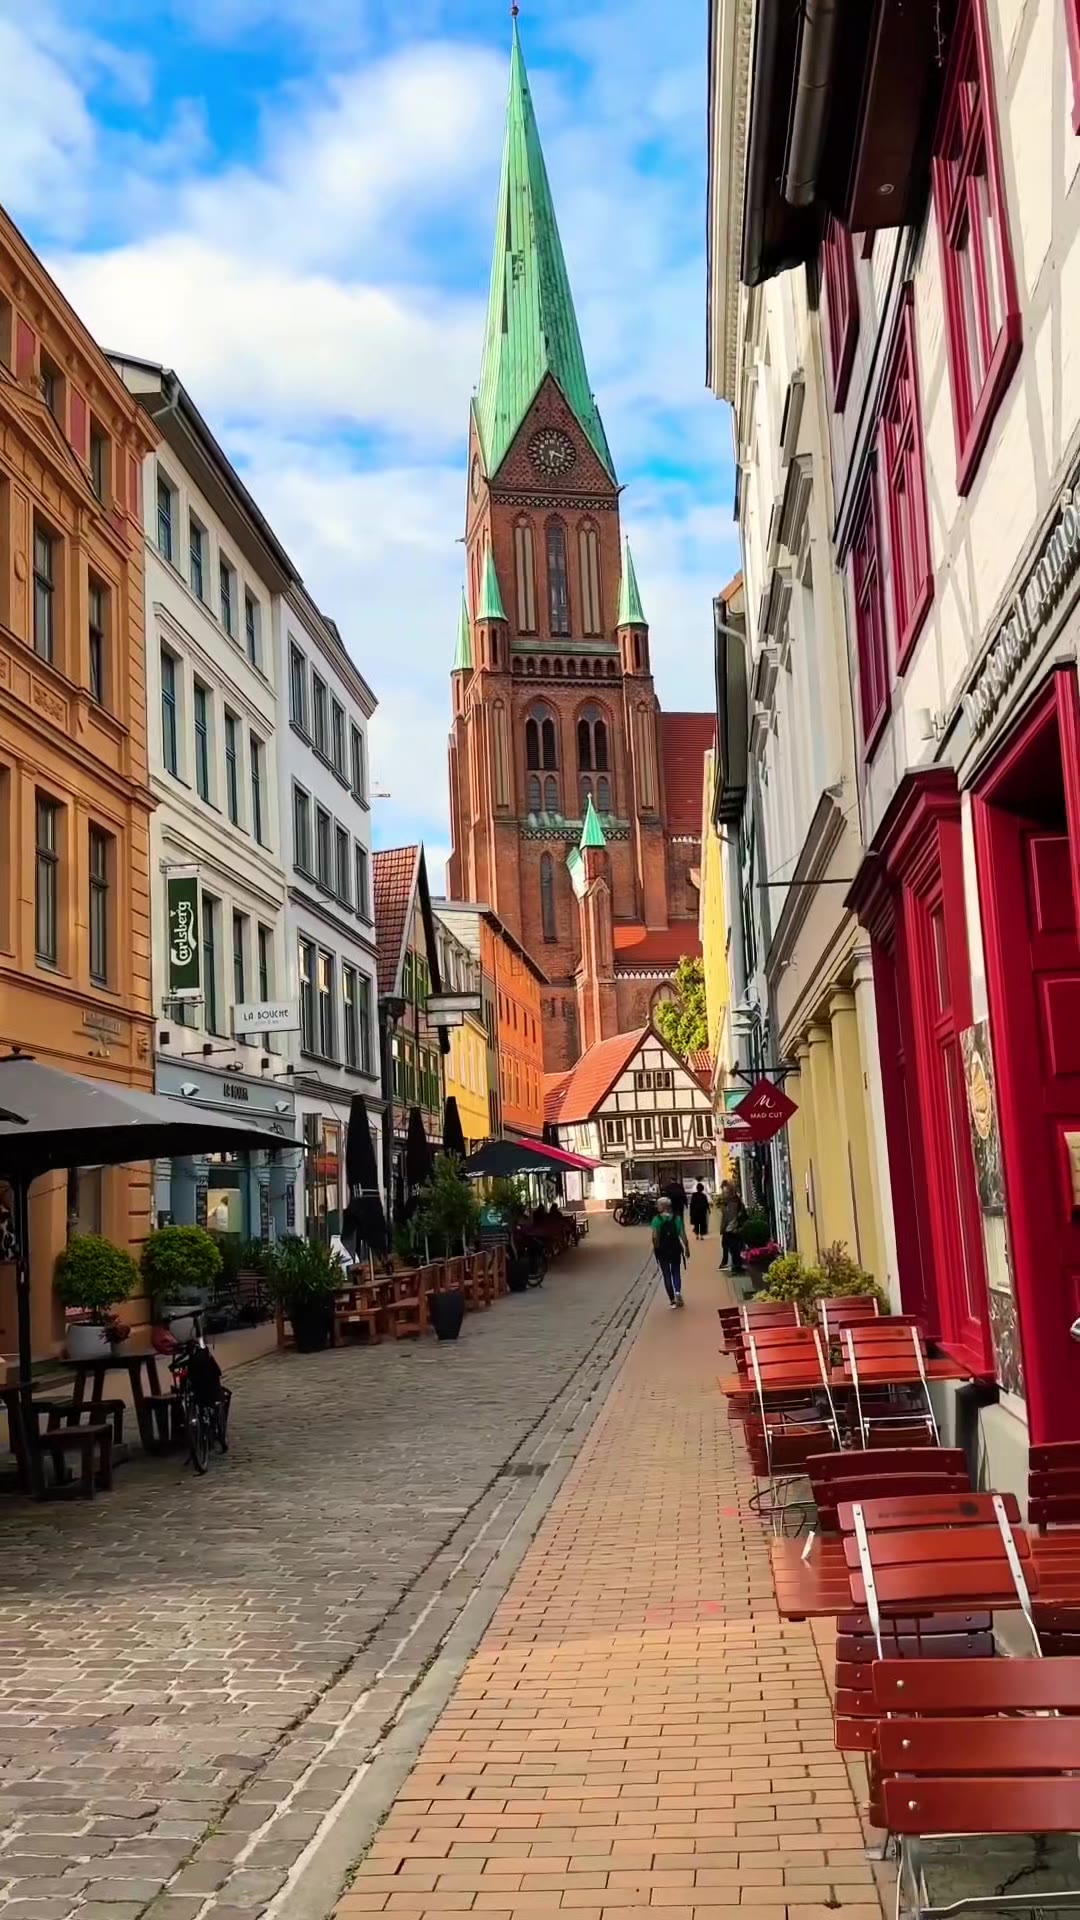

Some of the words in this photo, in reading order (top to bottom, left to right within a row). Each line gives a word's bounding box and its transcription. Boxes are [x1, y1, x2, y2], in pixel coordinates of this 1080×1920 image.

[171, 901, 196, 966] Carlsberg
[243, 1011, 254, 1021] LA
[257, 1009, 289, 1019] BOUCHE
[750, 1112, 767, 1120] MAD
[768, 1111, 784, 1119] CUT
